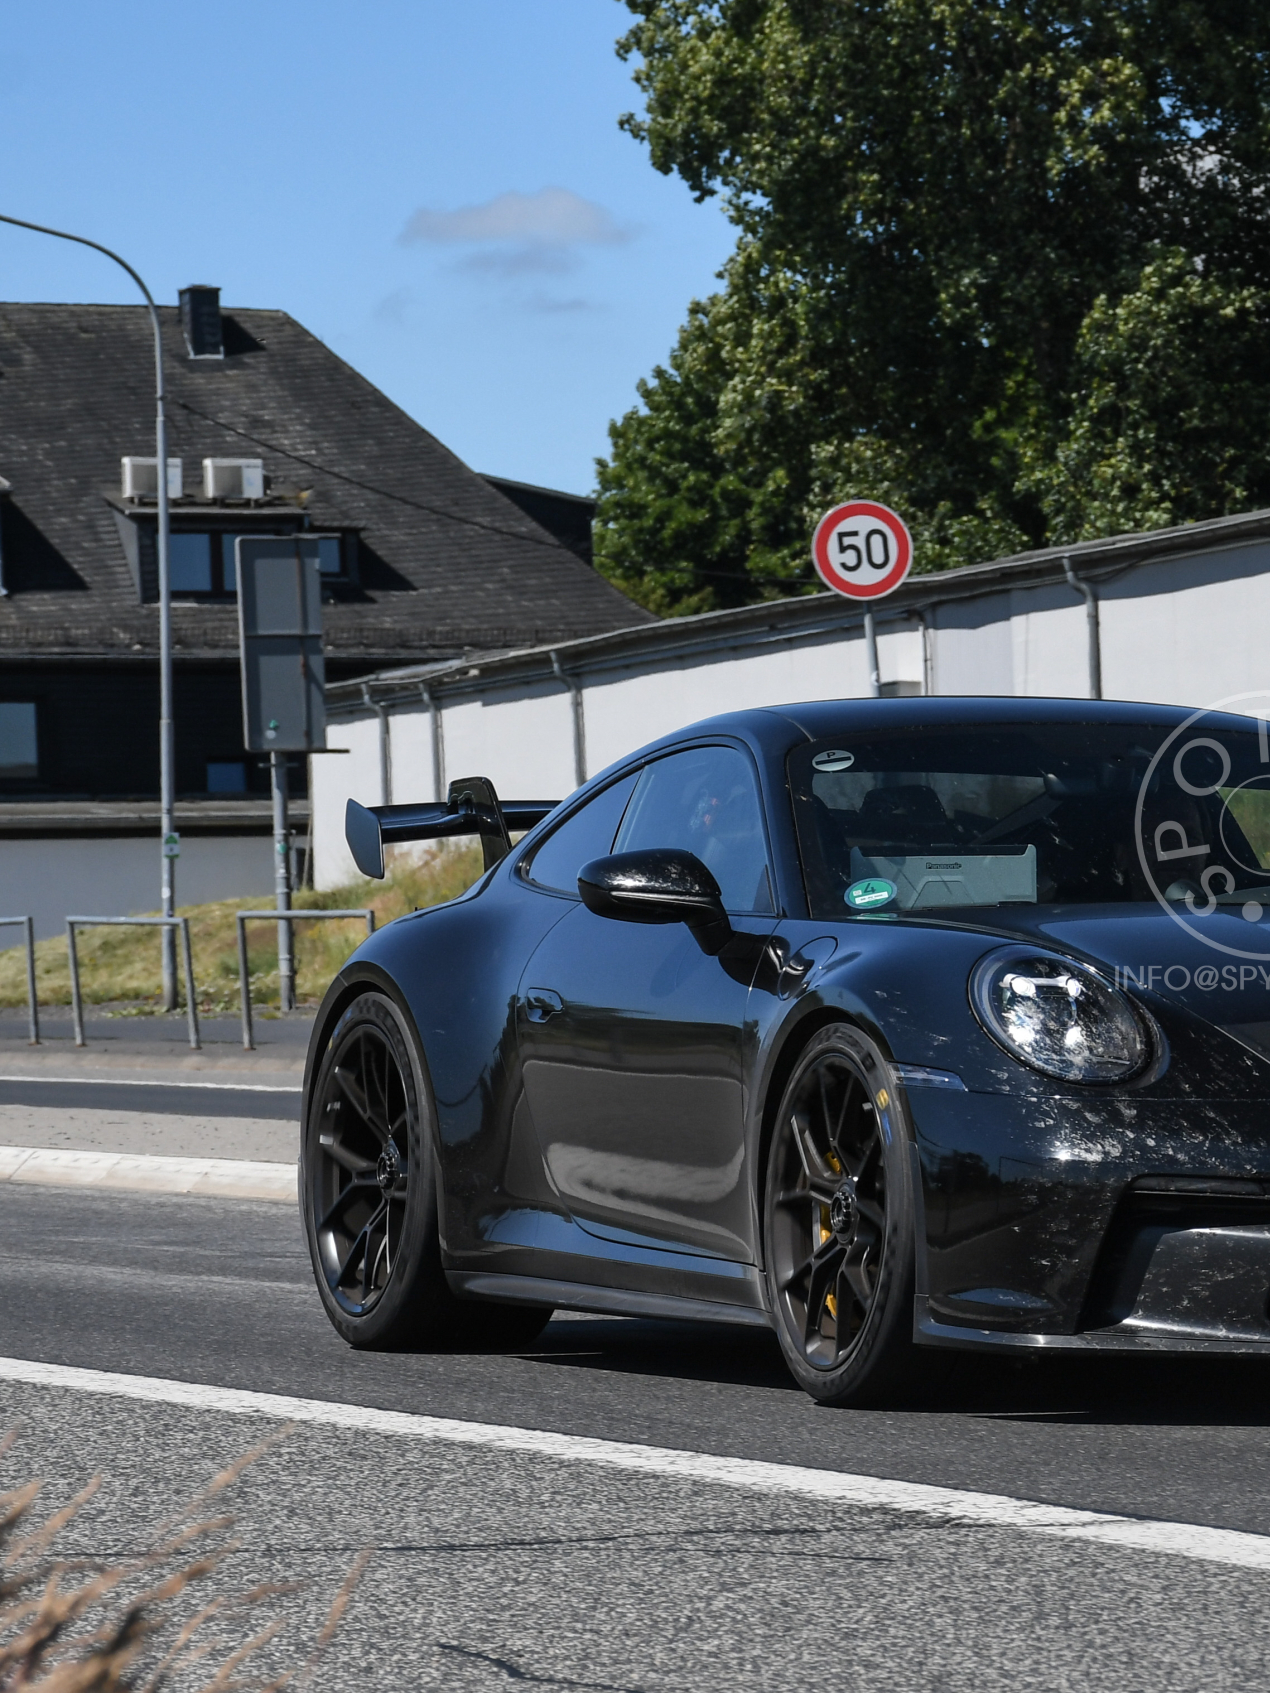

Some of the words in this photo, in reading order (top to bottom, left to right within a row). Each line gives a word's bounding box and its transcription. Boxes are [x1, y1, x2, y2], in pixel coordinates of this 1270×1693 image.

[837, 528, 890, 573] 50
[826, 751, 836, 759] P
[925, 861, 962, 870] Panasonic
[863, 882, 877, 894] 4
